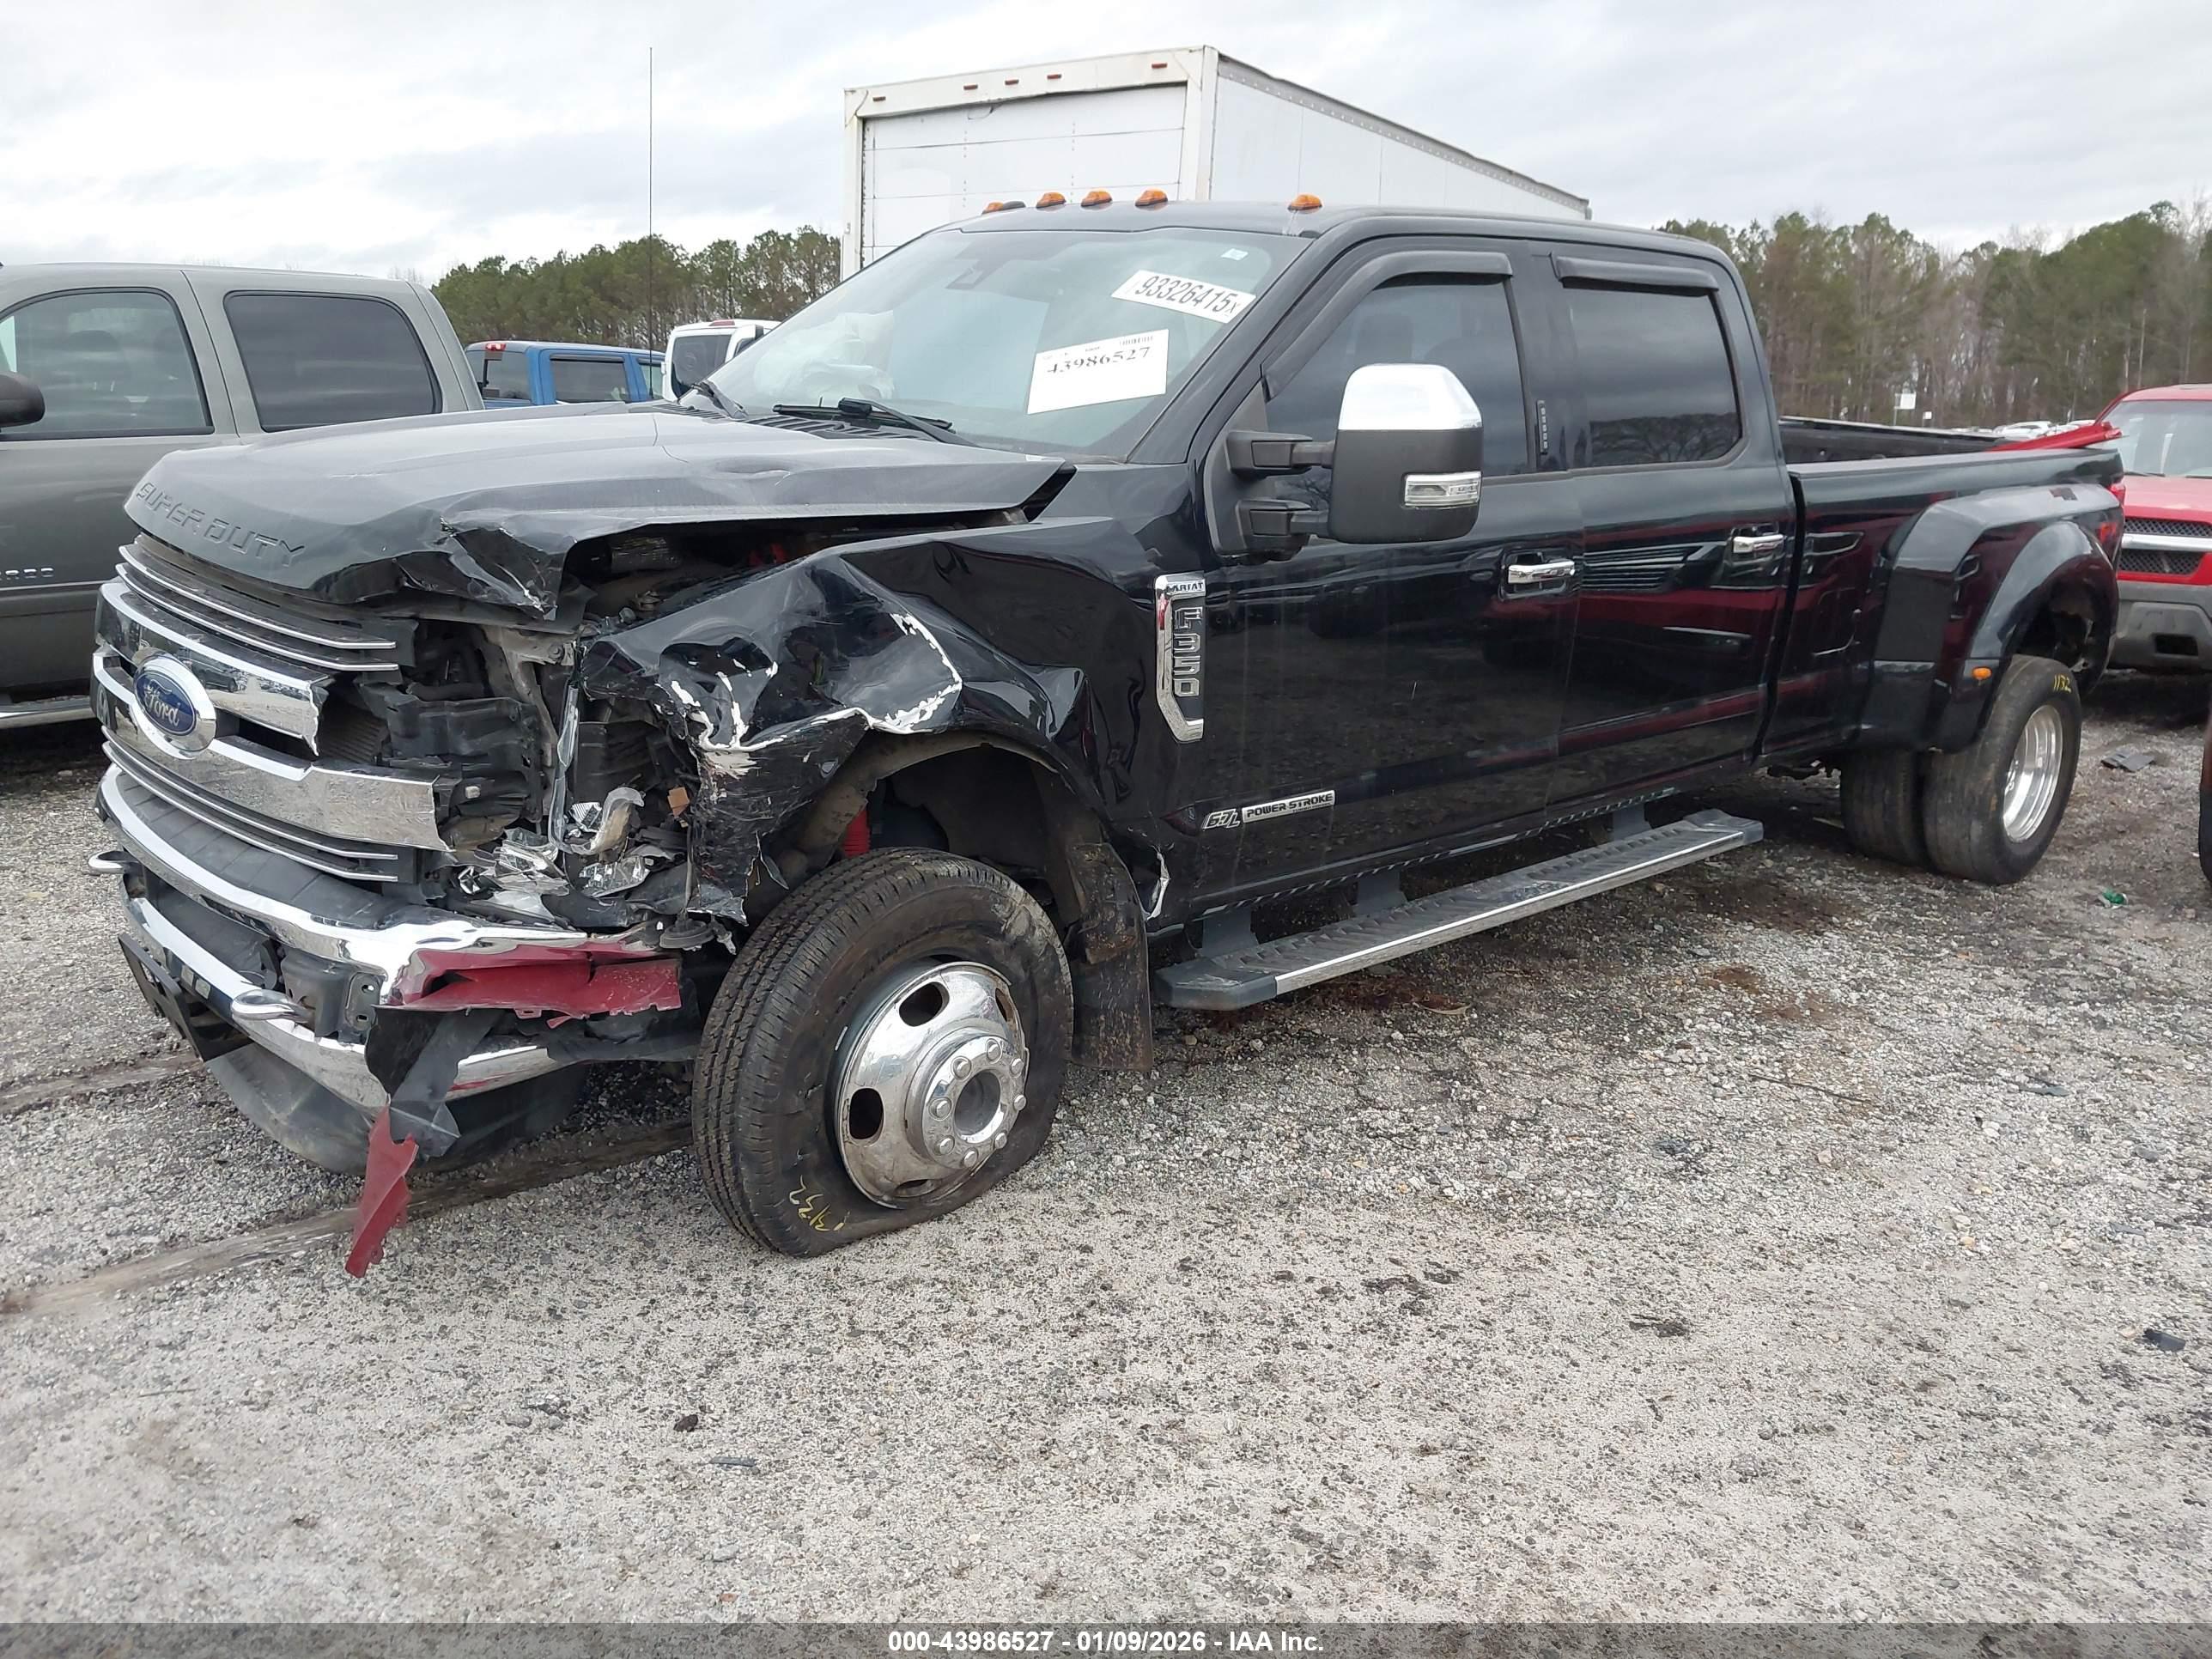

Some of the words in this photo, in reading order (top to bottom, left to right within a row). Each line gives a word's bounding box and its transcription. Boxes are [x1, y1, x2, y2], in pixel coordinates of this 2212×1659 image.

[1135, 276, 1237, 313] 93326415
[1047, 347, 1151, 374] 43986527
[136, 483, 205, 534] SUPER
[204, 518, 305, 567] DUTY
[143, 678, 181, 726] Ford
[1247, 803, 1286, 817] POWER
[1289, 793, 1334, 810] STROKE
